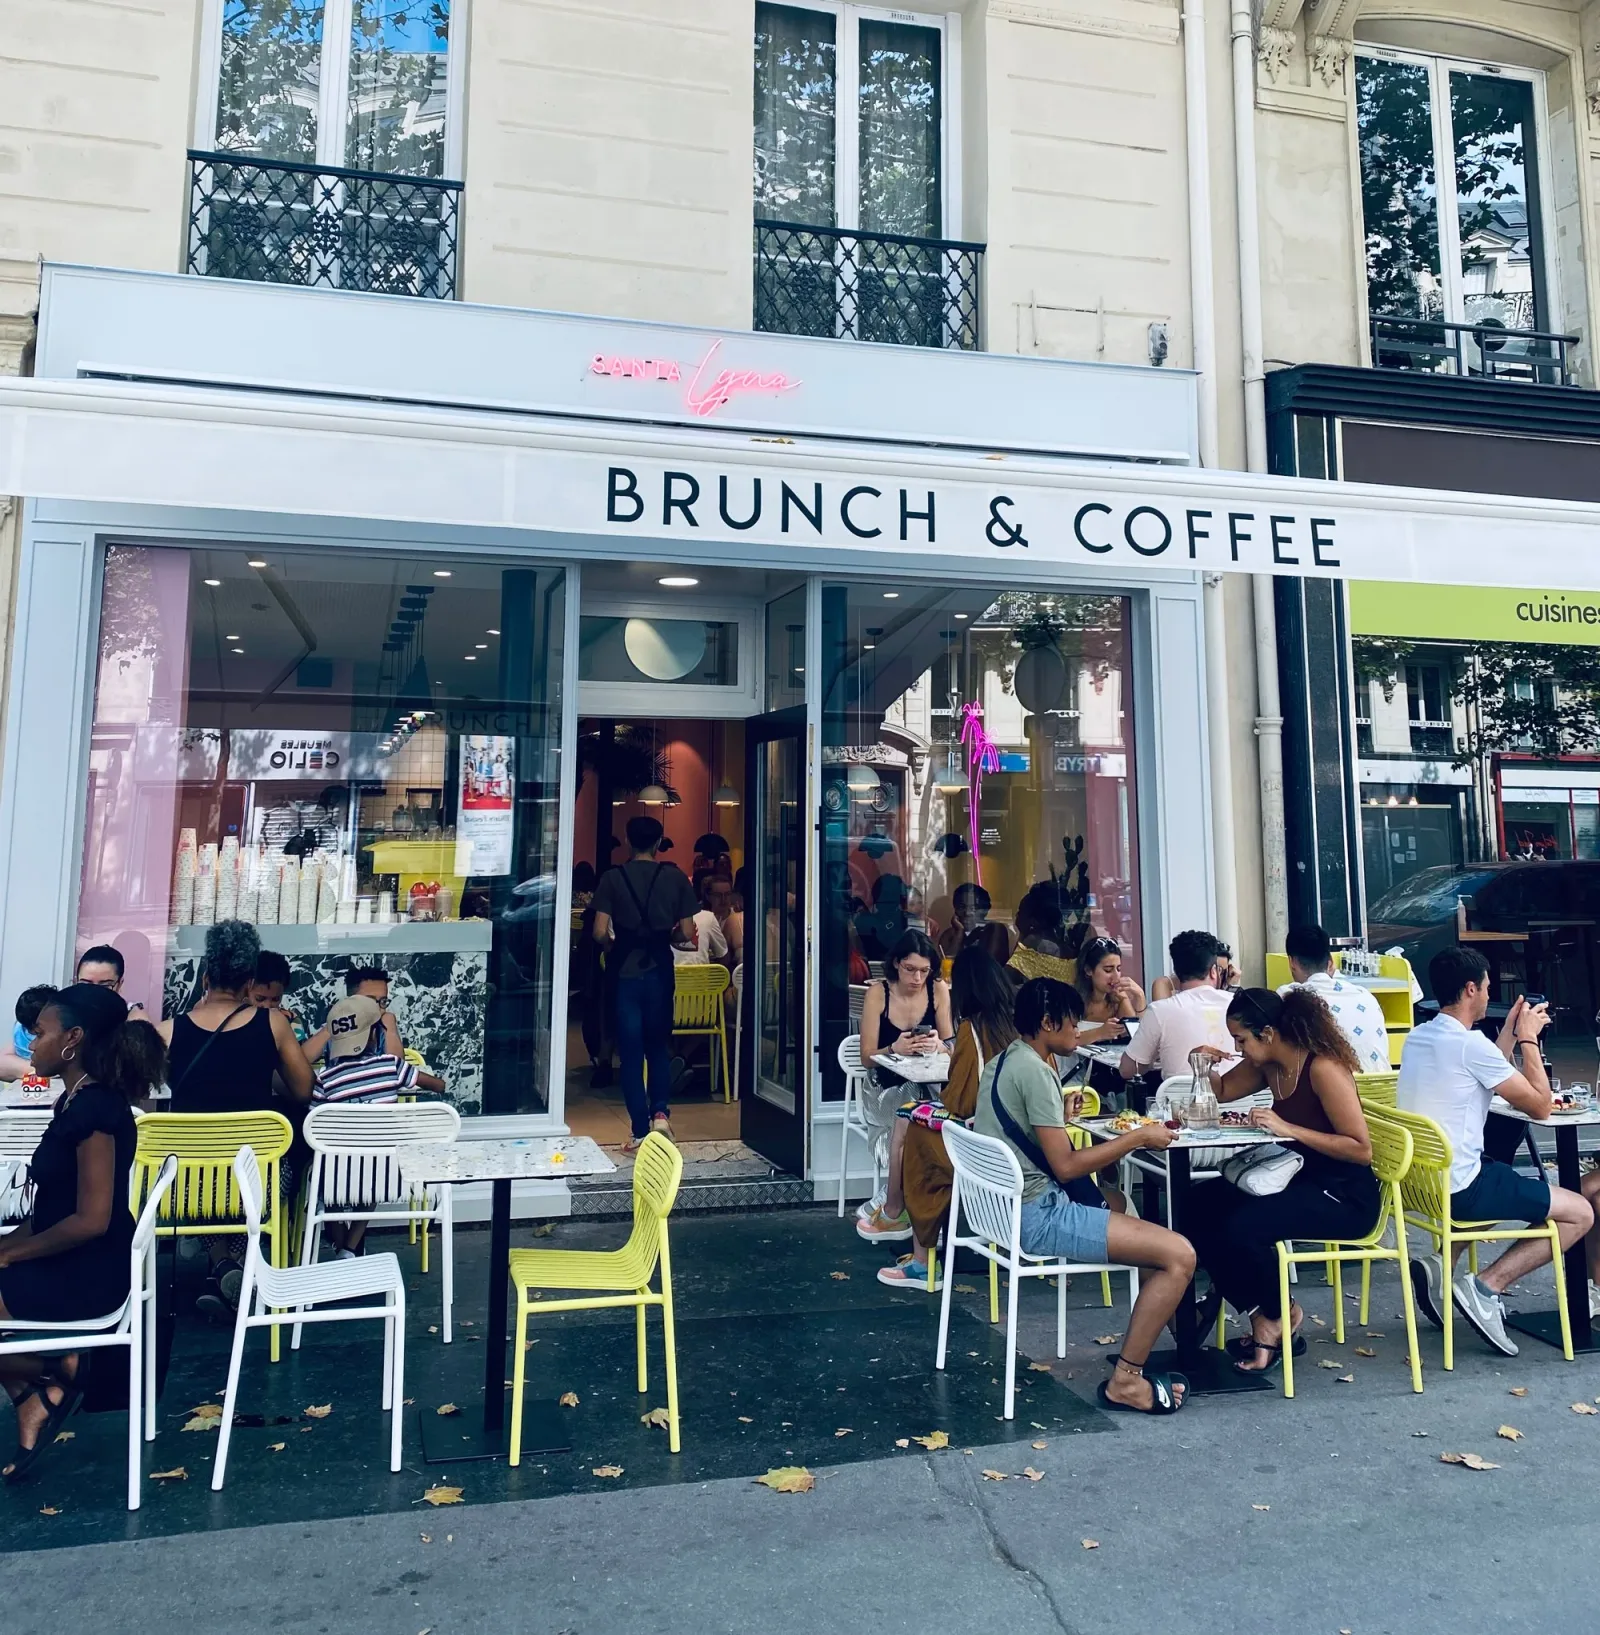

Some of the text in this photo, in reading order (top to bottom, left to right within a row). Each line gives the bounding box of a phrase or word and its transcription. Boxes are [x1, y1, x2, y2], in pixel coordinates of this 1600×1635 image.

[589, 354, 681, 380] SANTA
[606, 467, 1341, 566] BRUNCH & COFFEE
[1516, 595, 1600, 624] cuisine
[430, 711, 530, 734] RUNCH
[331, 1013, 358, 1035] CSI
